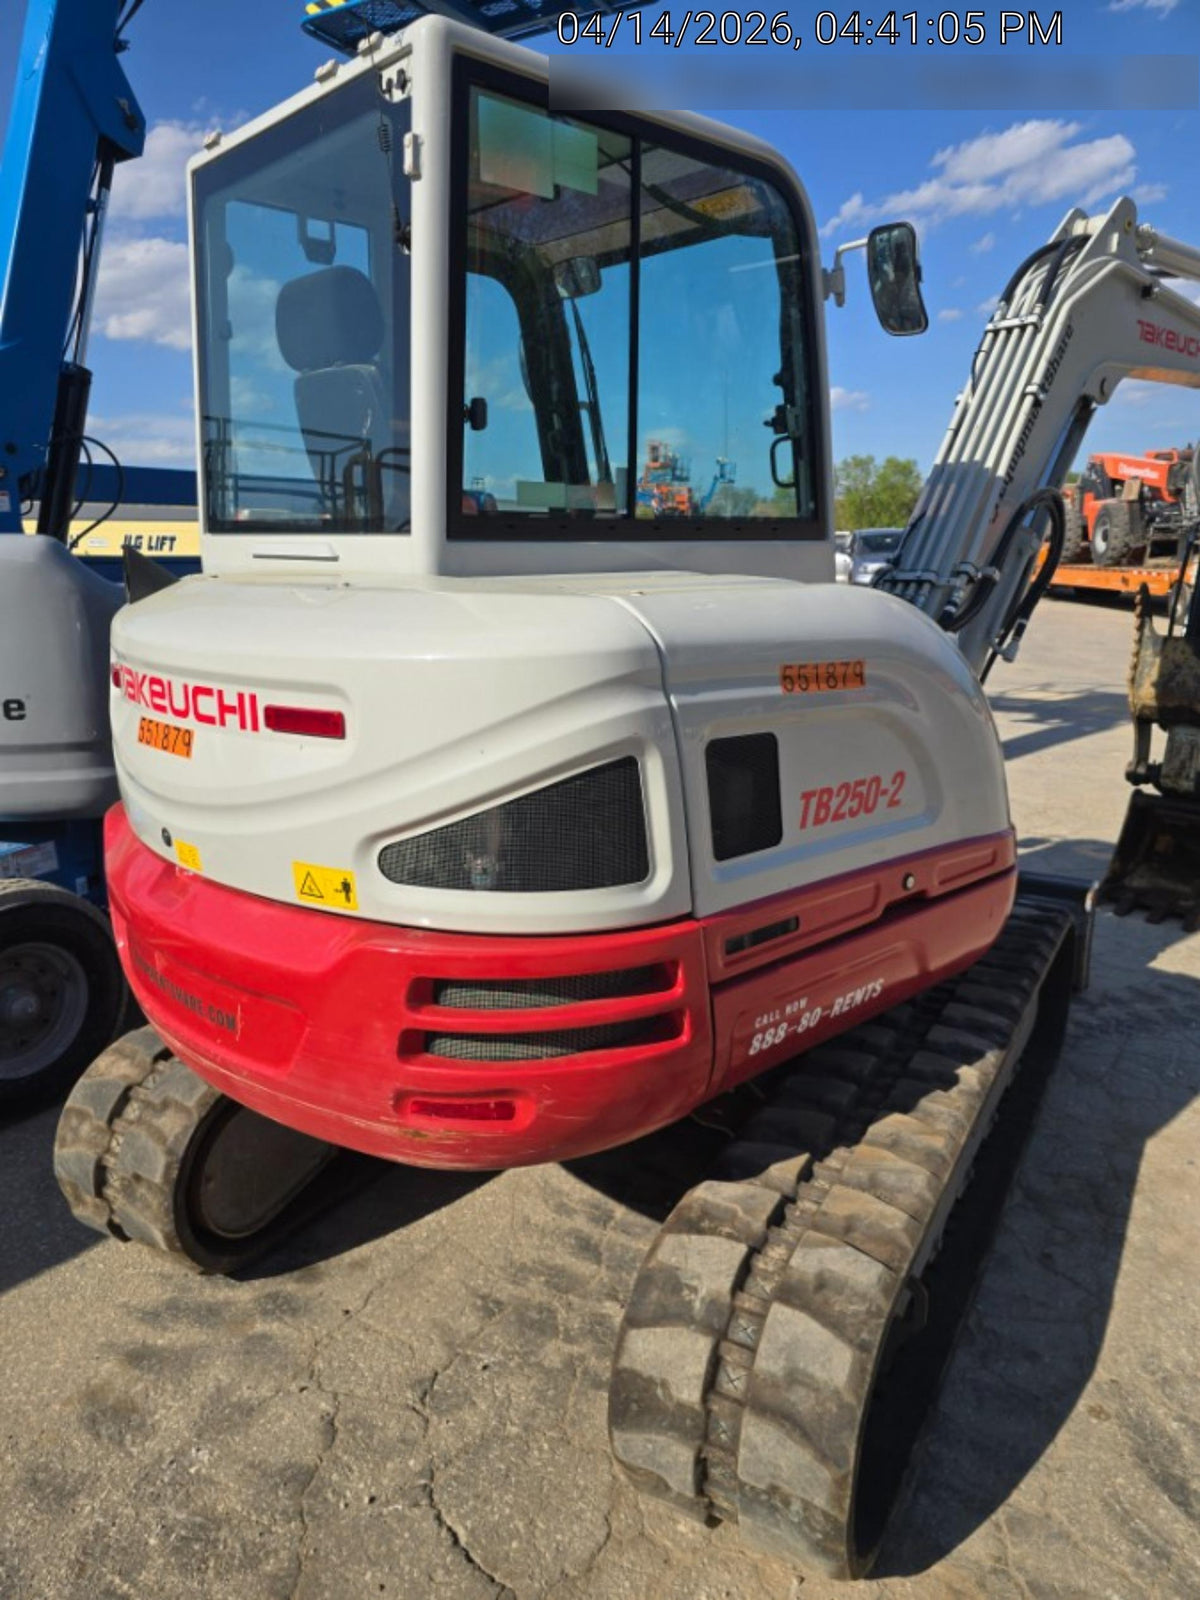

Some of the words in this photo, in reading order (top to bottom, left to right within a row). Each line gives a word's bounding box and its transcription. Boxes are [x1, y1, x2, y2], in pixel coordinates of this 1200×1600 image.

[147, 534, 177, 551] LIFT
[781, 660, 865, 693] 551879
[138, 716, 192, 758] 551879
[799, 769, 907, 830] TB250-2
[748, 977, 885, 1056] 888-80-RENTS
[754, 1008, 781, 1028] CALL
[785, 997, 808, 1016] NOW
